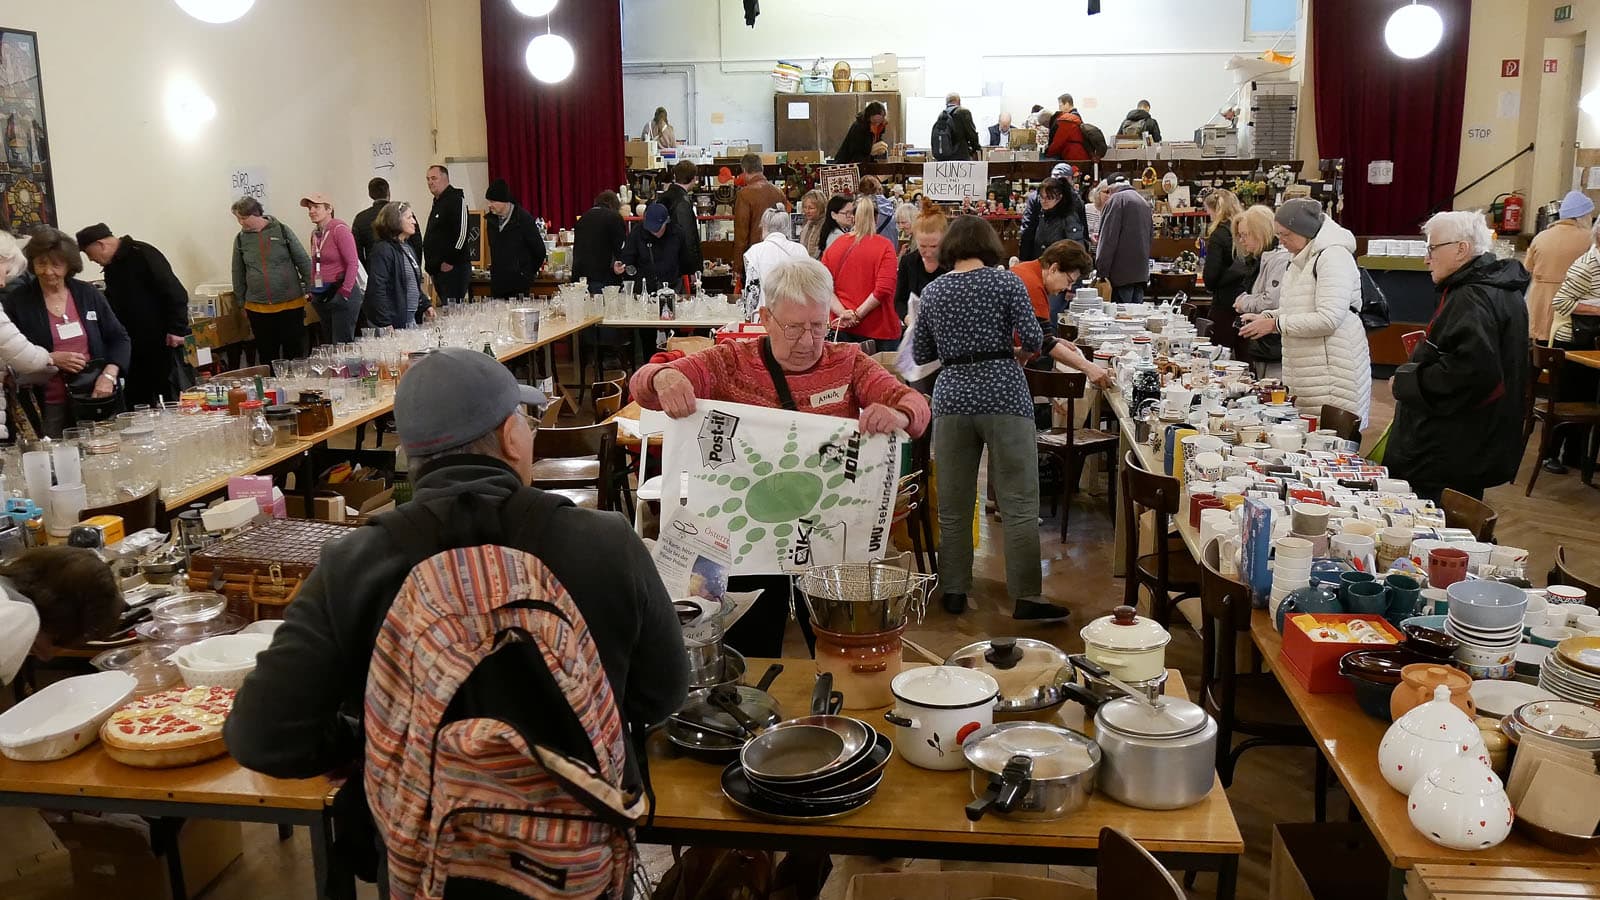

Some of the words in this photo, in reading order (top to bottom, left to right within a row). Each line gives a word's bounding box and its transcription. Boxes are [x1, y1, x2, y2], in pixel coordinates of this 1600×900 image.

[1467, 129, 1492, 139] STOP
[935, 162, 976, 178] KUNST
[926, 183, 981, 197] KREMPEL
[709, 415, 725, 462] Post-it
[868, 526, 885, 552] UHU
